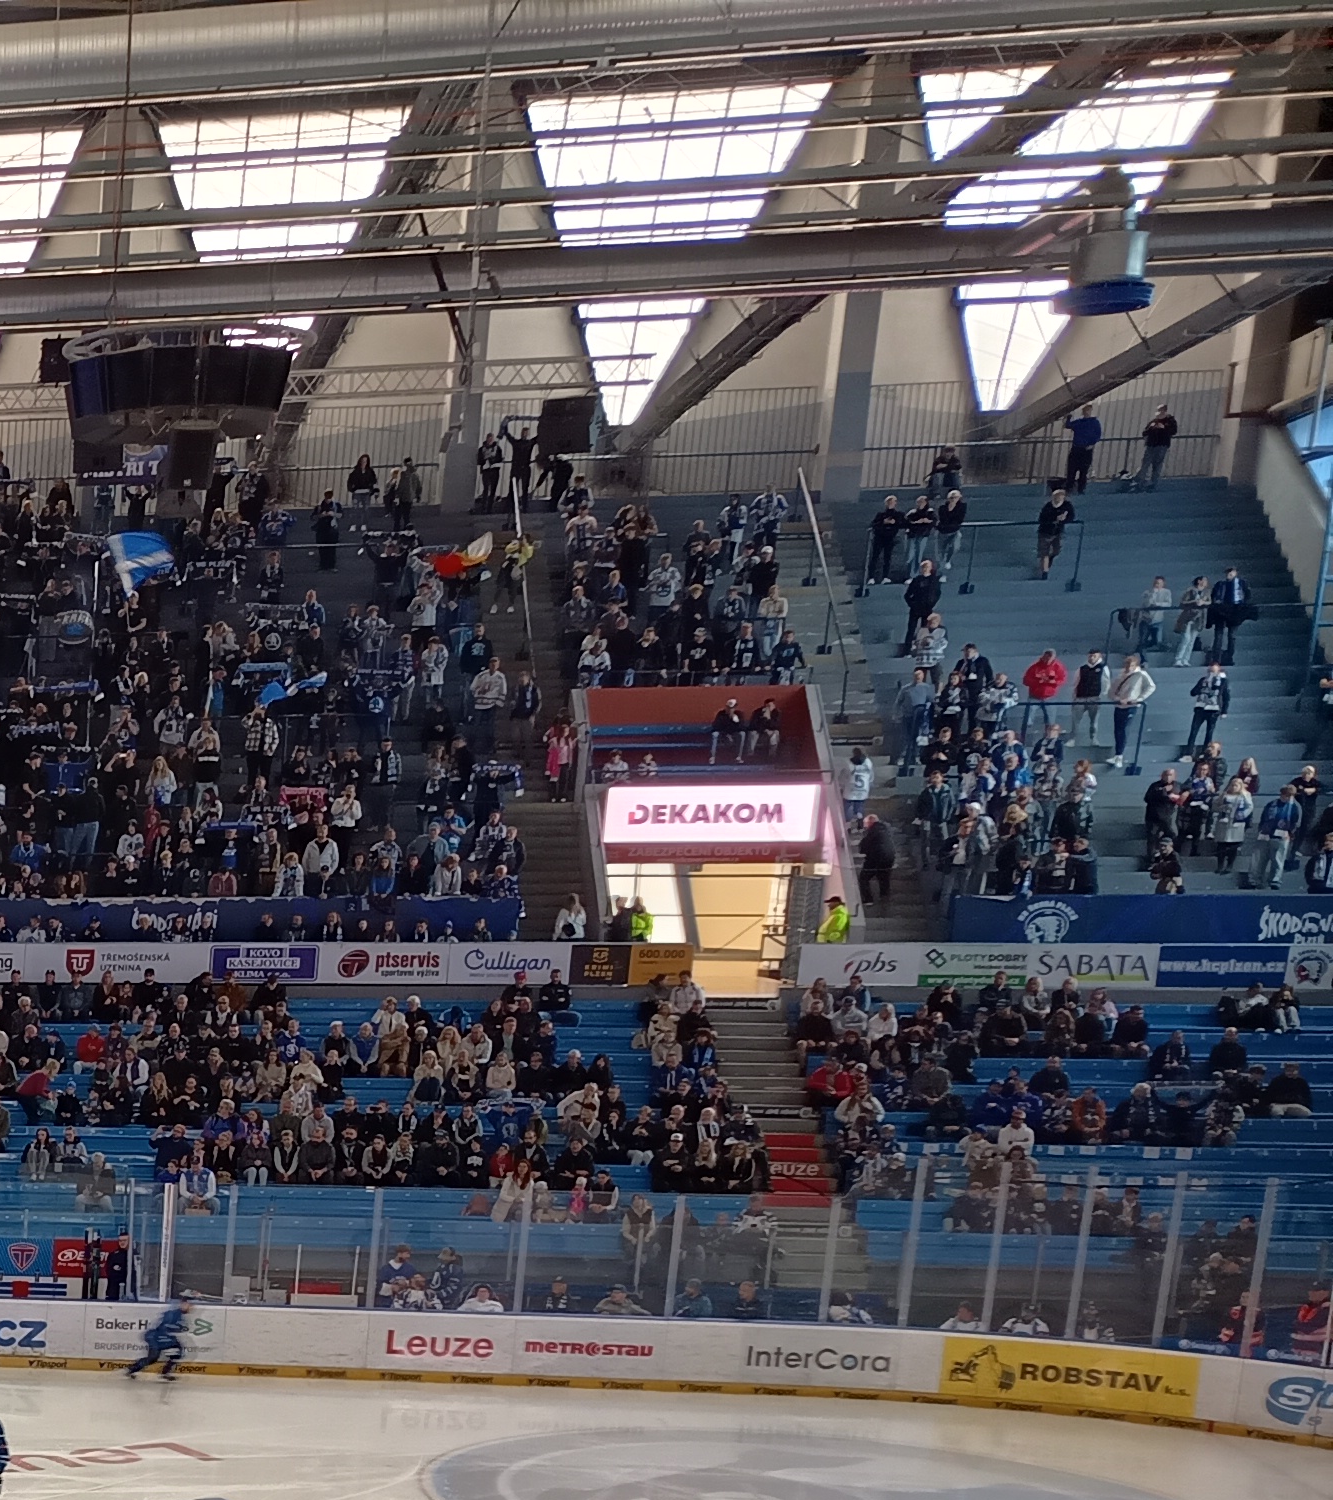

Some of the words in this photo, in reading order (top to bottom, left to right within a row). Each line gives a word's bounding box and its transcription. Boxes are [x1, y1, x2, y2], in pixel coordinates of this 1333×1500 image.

[627, 803, 783, 825] DEKAKOM
[101, 951, 170, 963] TŘEMOŠENSKÁ
[228, 958, 298, 968] KASEJOVICE
[249, 949, 280, 958] KOVO
[375, 950, 440, 972] ptservis
[465, 949, 552, 974] Culligan
[852, 952, 897, 976] pbs
[1037, 950, 1149, 981] ŠABATA
[1160, 959, 1285, 975] www.hcplzen.cz
[95, 1318, 132, 1331] Baker
[386, 1329, 494, 1358] Leuze
[746, 1344, 891, 1374] InterCora
[1019, 1362, 1163, 1394] ROBSTAV
